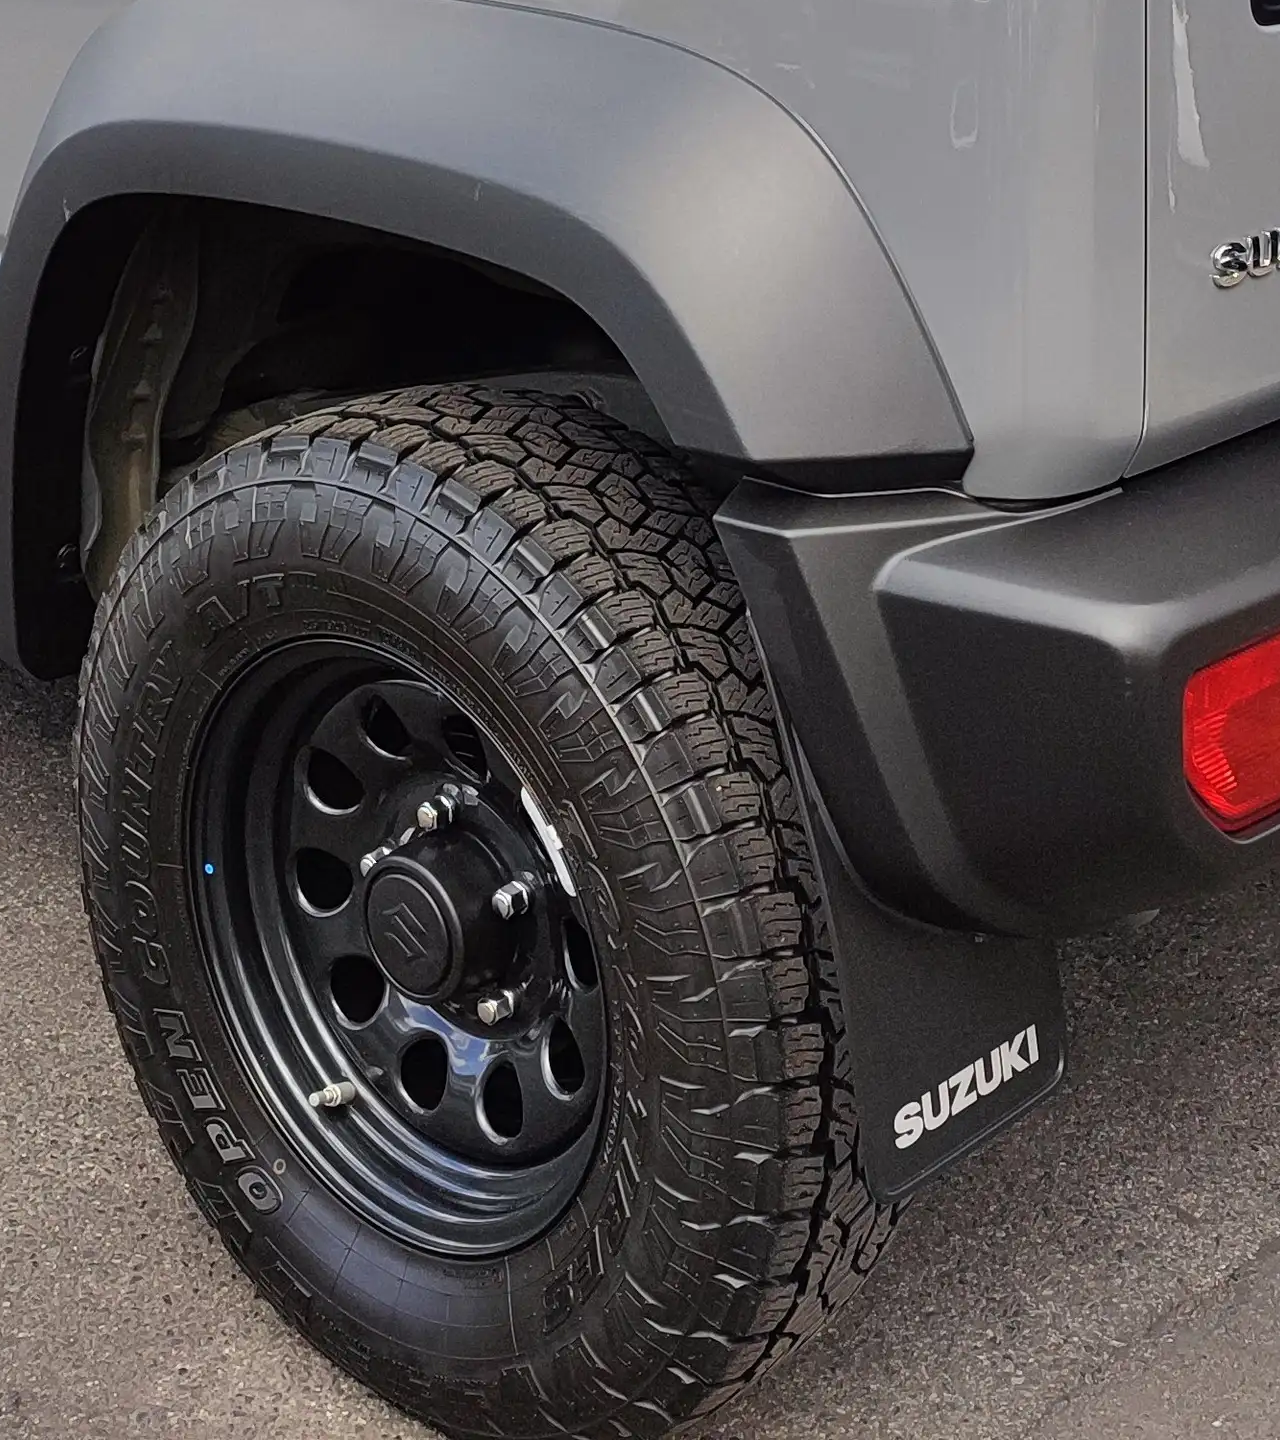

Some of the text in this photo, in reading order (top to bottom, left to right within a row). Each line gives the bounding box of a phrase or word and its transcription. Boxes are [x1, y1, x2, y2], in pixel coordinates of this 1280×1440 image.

[120, 639, 182, 987] COUNTRY
[153, 1007, 284, 1216] OPEN
[893, 1023, 1040, 1150] SUZUKI
